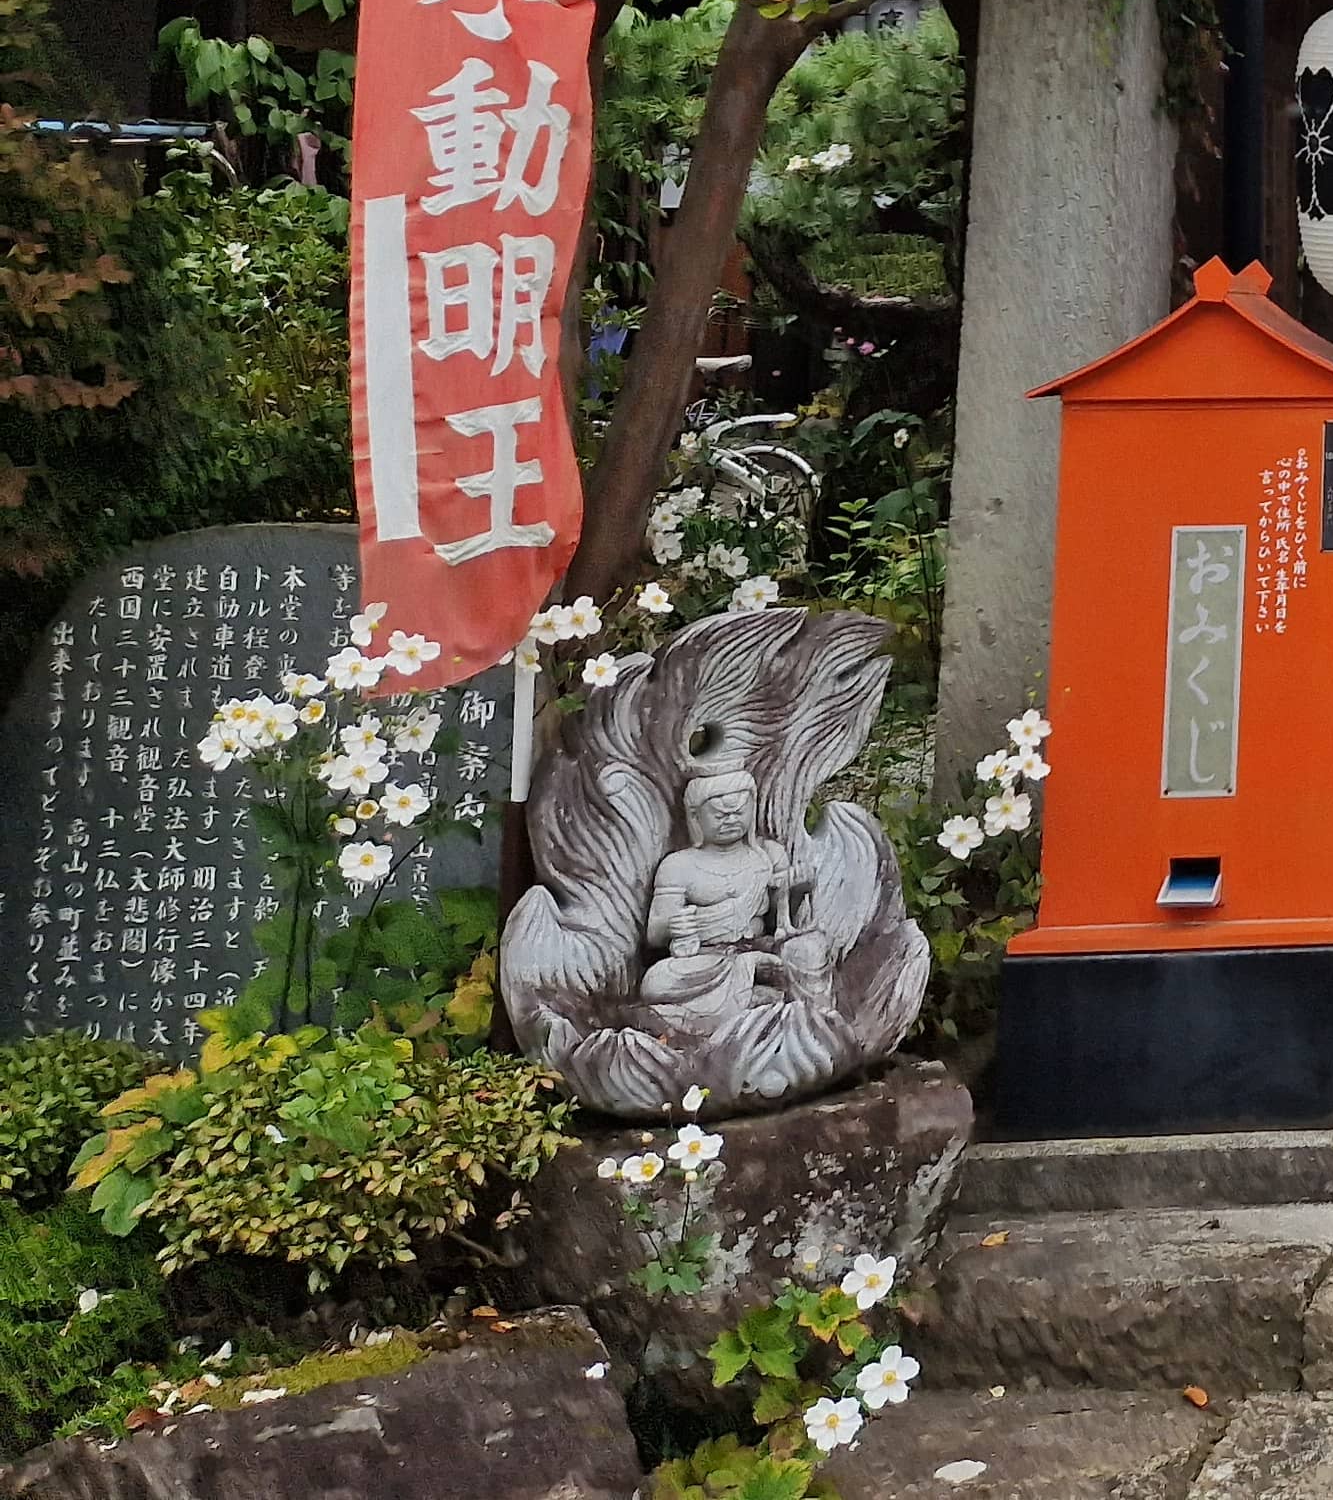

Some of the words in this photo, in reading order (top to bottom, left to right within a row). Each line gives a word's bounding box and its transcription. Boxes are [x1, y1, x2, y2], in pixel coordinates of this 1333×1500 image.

[1255, 468, 1274, 634] 言ってからひいて下さい
[1275, 536, 1290, 565] 氏名
[1178, 539, 1231, 785] おみくじ
[148, 564, 209, 1057] 建立されました弘法大師修行像が大
